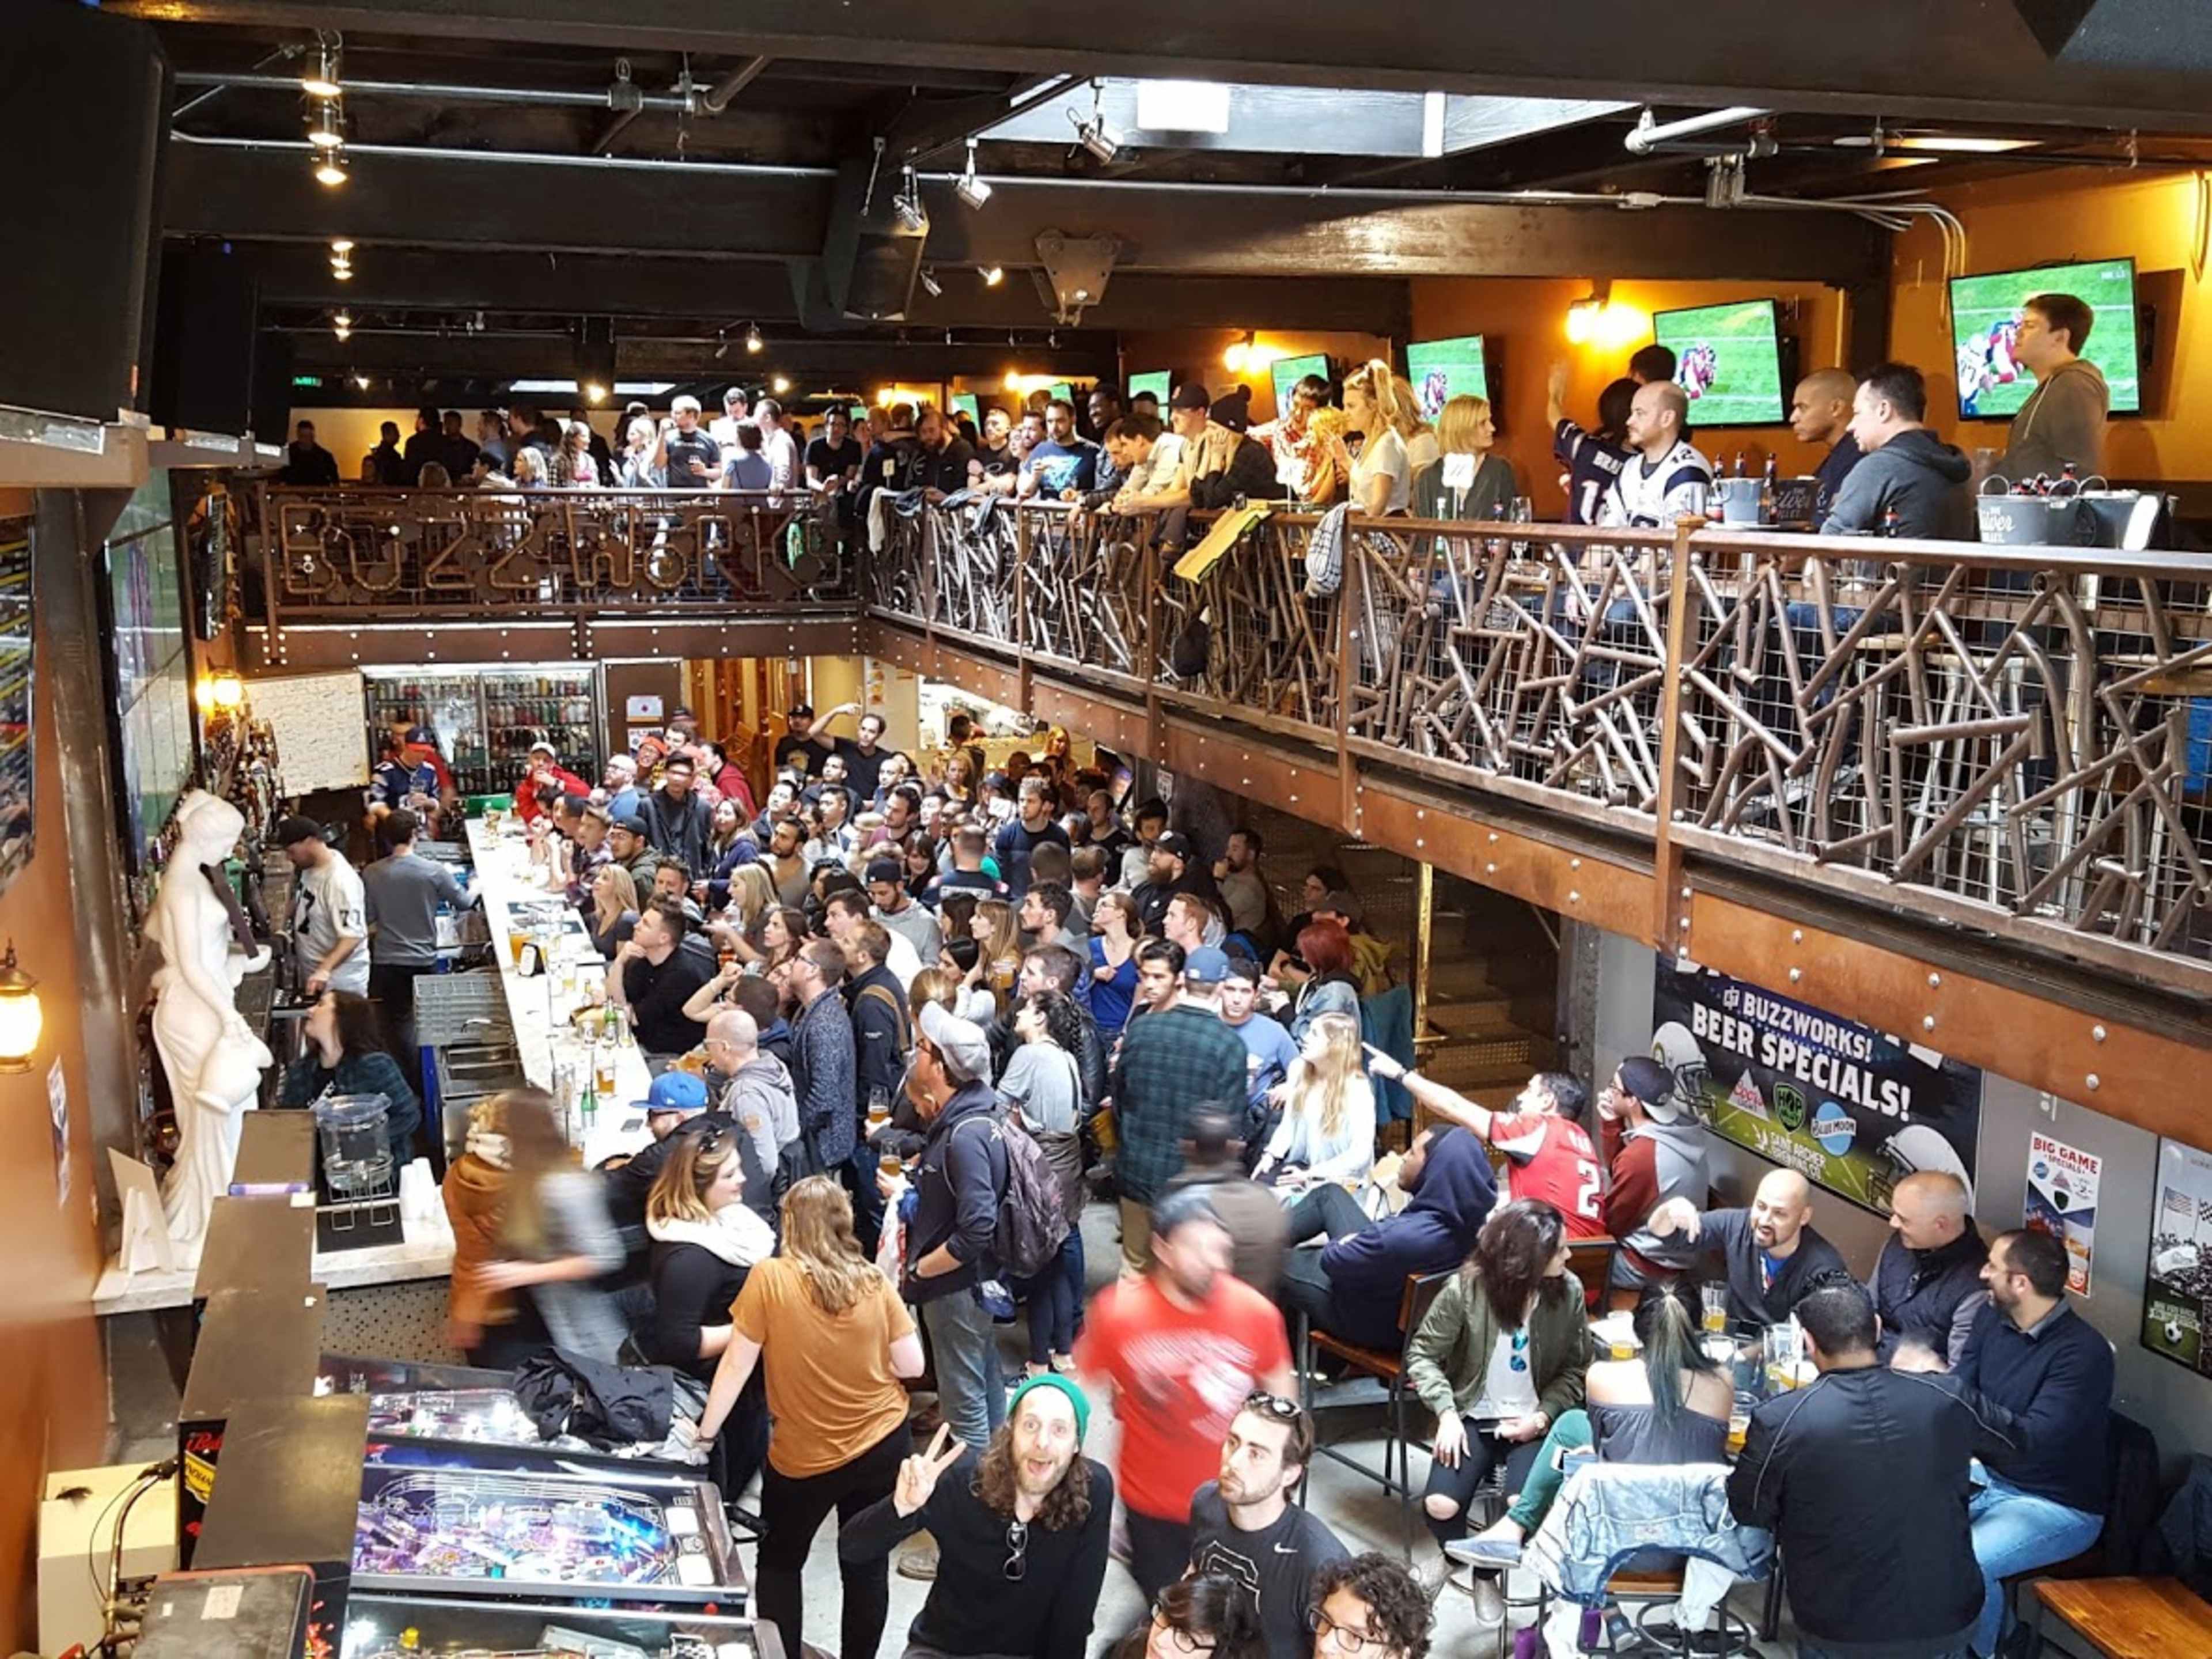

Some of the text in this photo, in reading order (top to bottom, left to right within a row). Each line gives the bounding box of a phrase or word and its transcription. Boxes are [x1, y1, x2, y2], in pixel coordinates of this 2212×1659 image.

[1692, 1001, 1754, 1059] BEER
[1761, 1032, 1911, 1122] SPECIALS!
[1743, 991, 1873, 1063] BUZZWORKS!
[2033, 1137, 2098, 1175] BIG GAME
